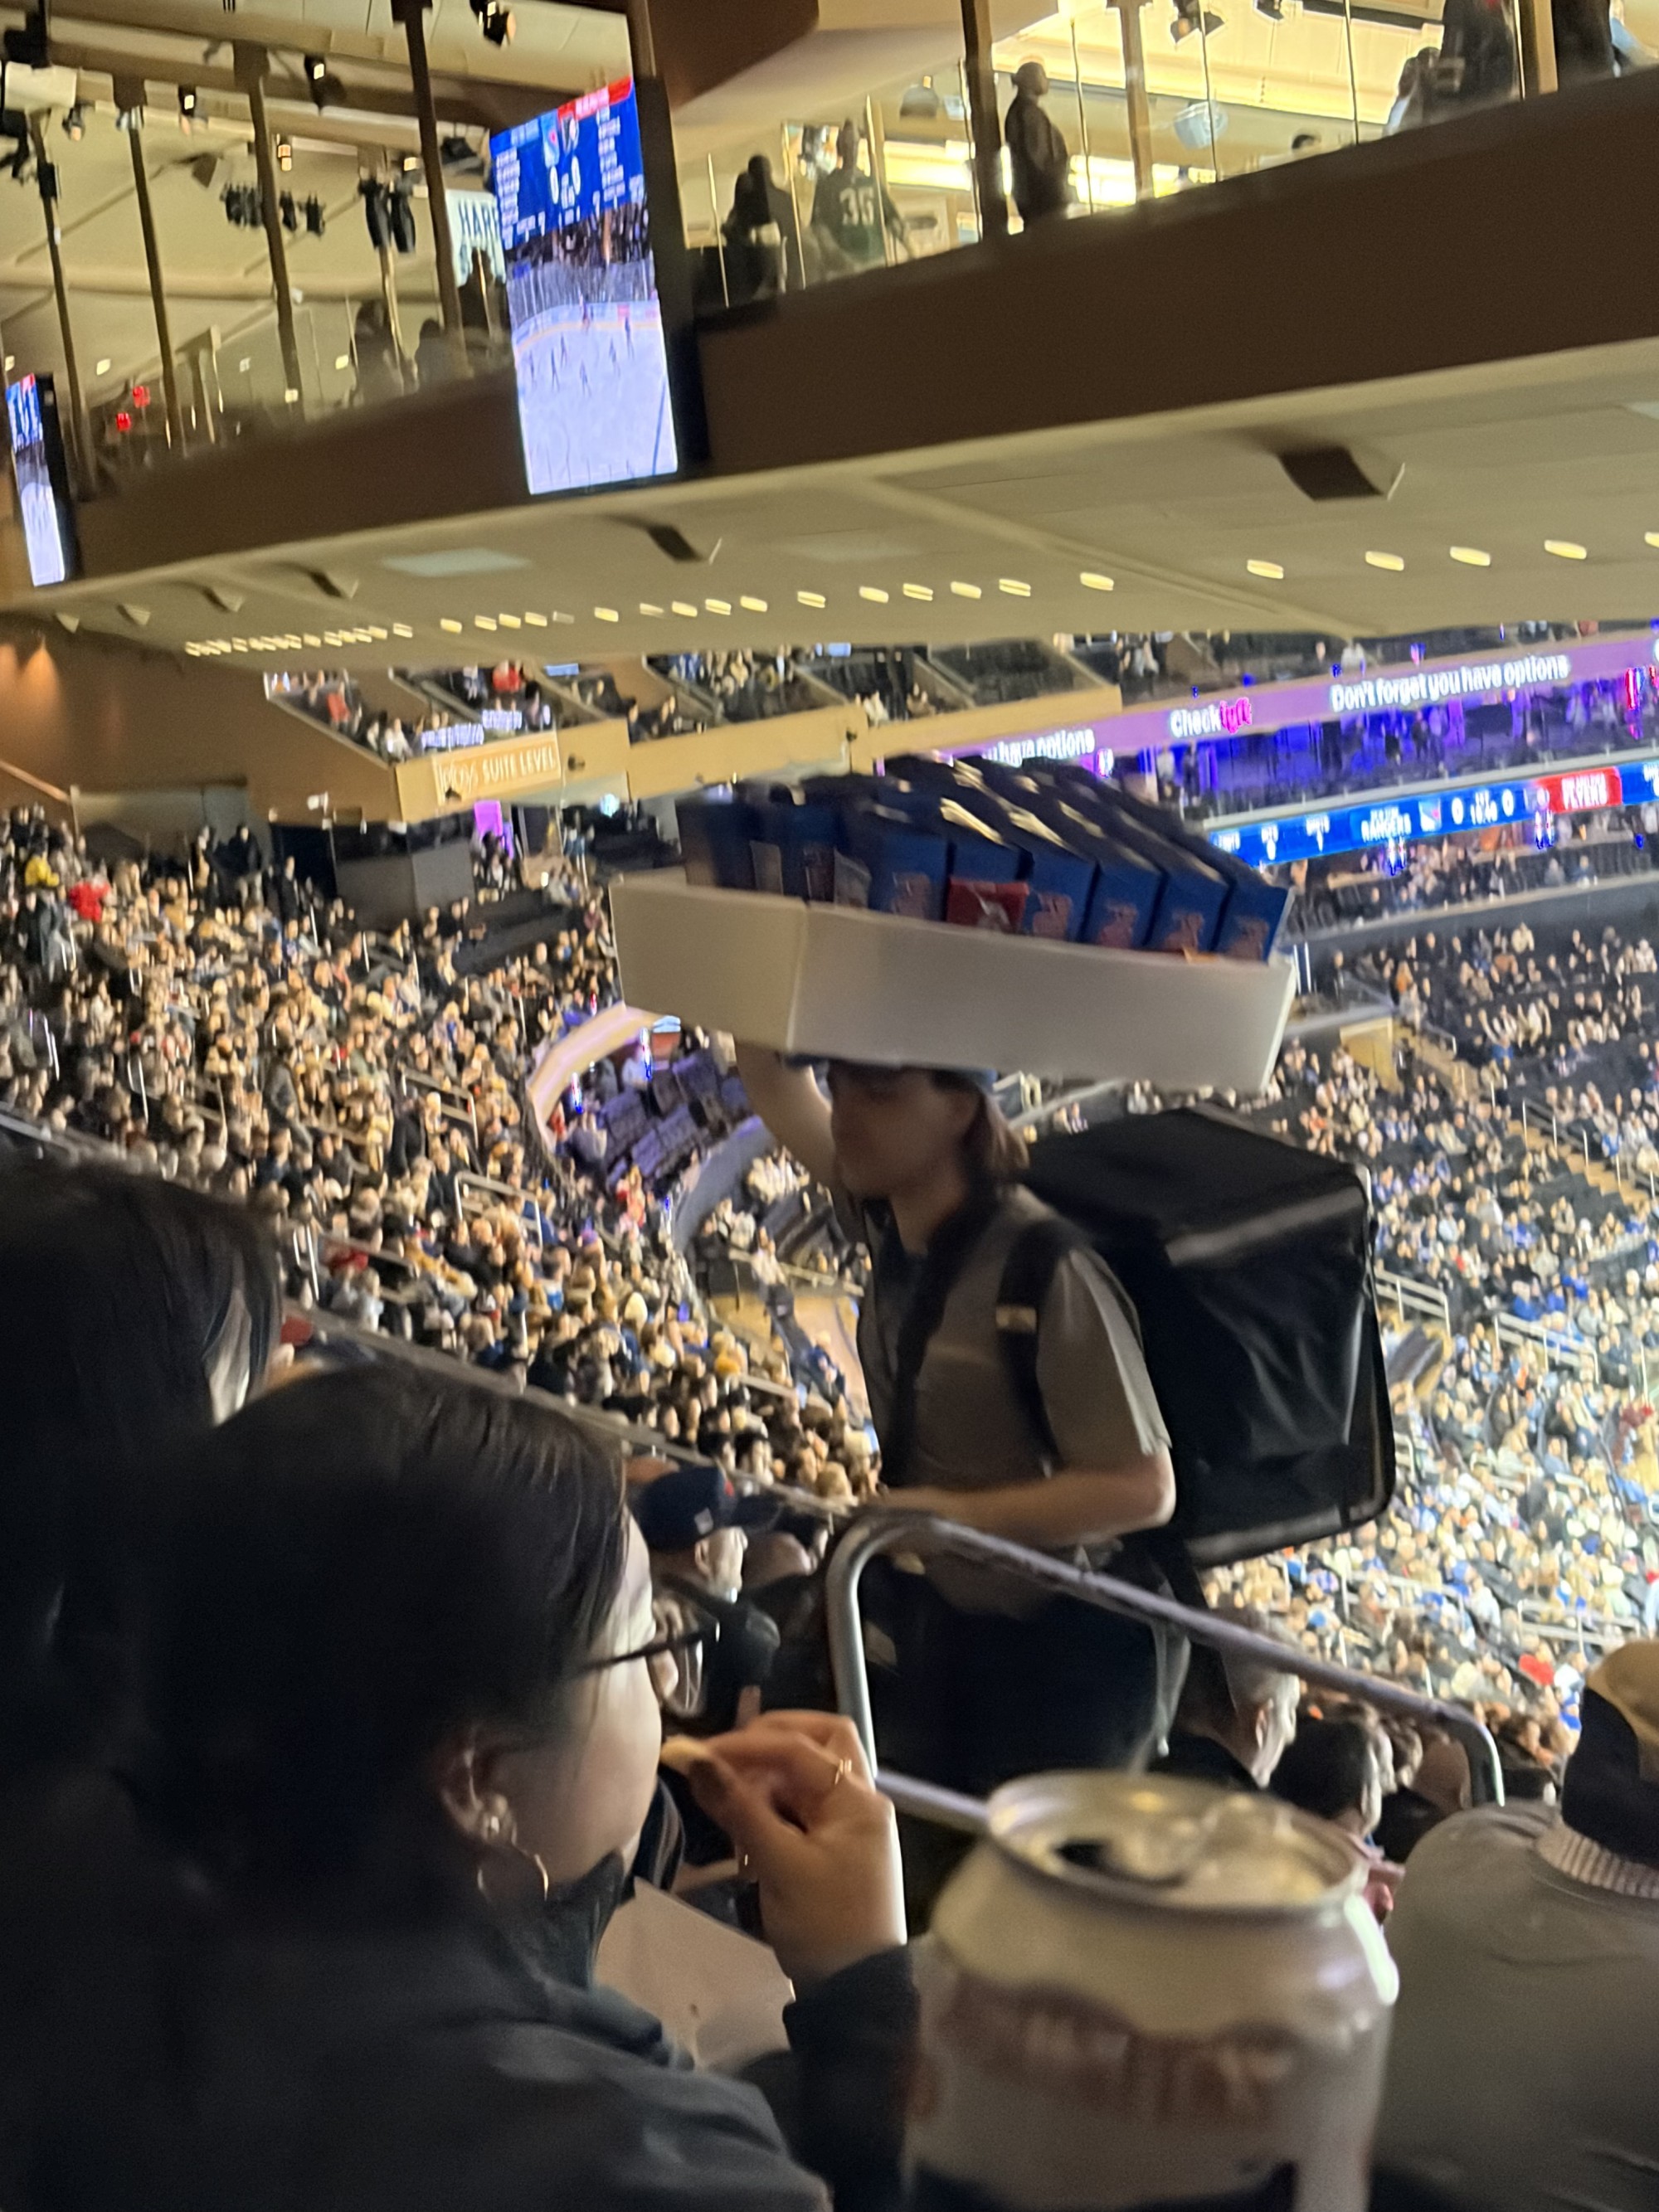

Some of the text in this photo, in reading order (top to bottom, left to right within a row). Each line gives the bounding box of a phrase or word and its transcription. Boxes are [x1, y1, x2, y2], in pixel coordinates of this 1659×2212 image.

[1331, 654, 1570, 712] Don't forget you have options
[1170, 697, 1253, 738] Check lyft
[482, 753, 518, 786] SUITE
[519, 745, 557, 776] LEVEL
[1451, 797, 1464, 825] 0
[1501, 789, 1515, 818] 0
